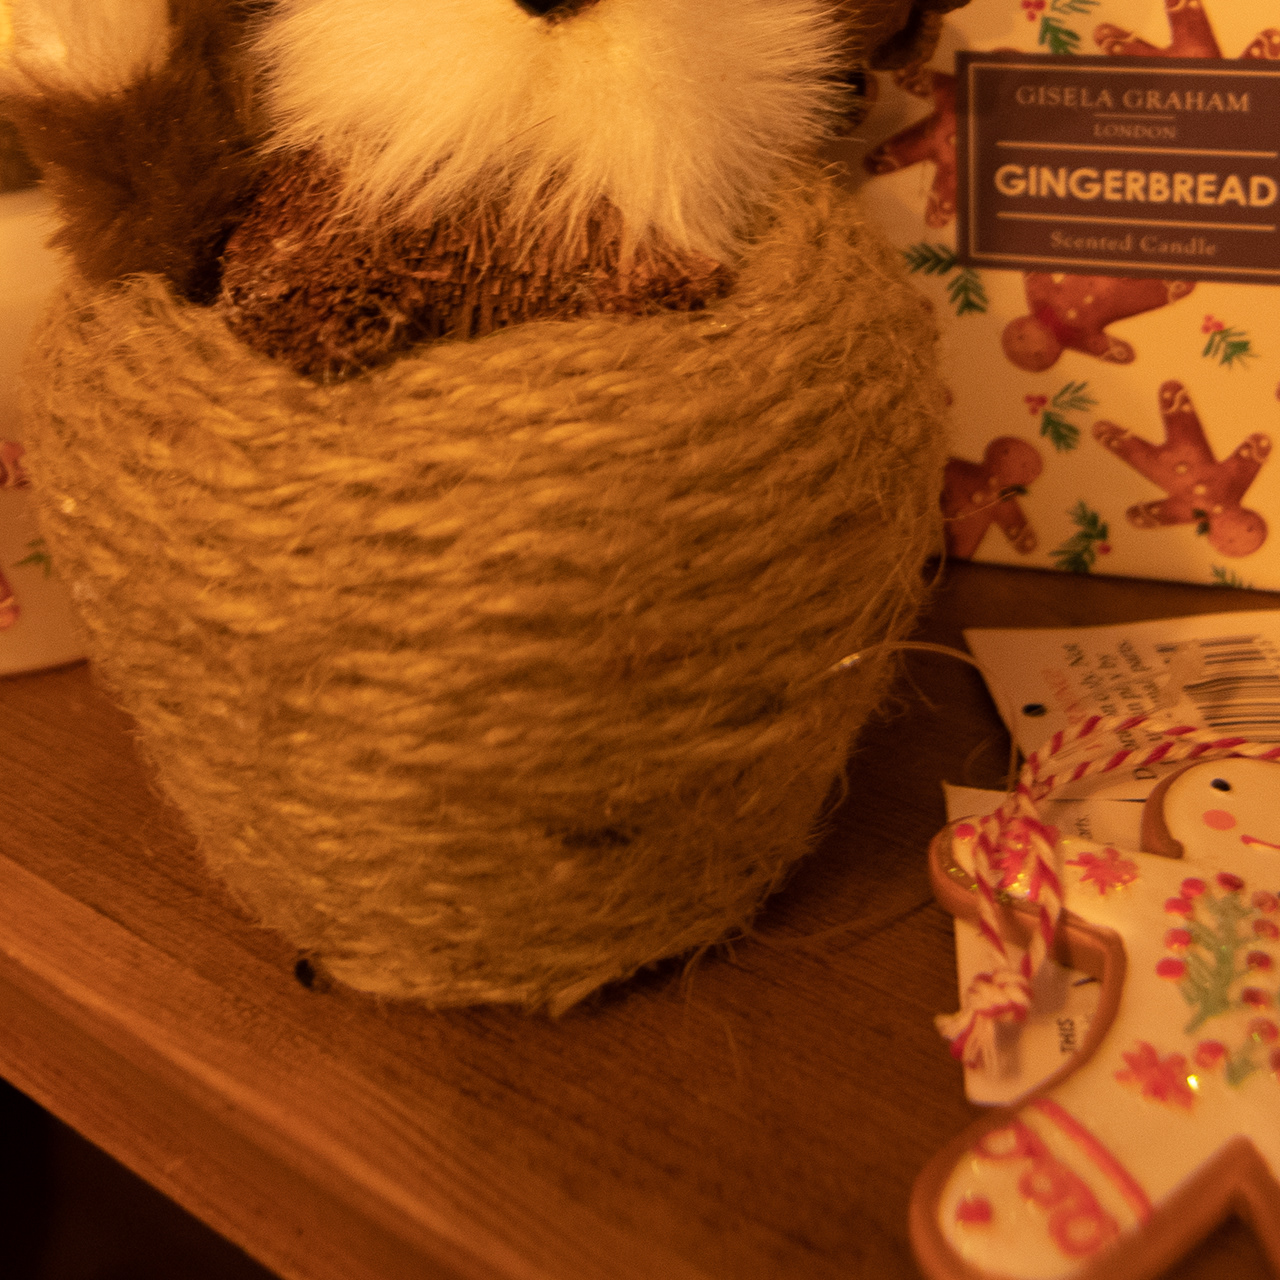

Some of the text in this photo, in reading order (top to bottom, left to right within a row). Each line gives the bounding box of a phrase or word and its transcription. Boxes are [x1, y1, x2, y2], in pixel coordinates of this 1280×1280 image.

[1015, 85, 1251, 113] GISELA GRAHAM
[994, 164, 1279, 208] GINGERBREAD
[1051, 230, 1217, 257] Scented Candle
